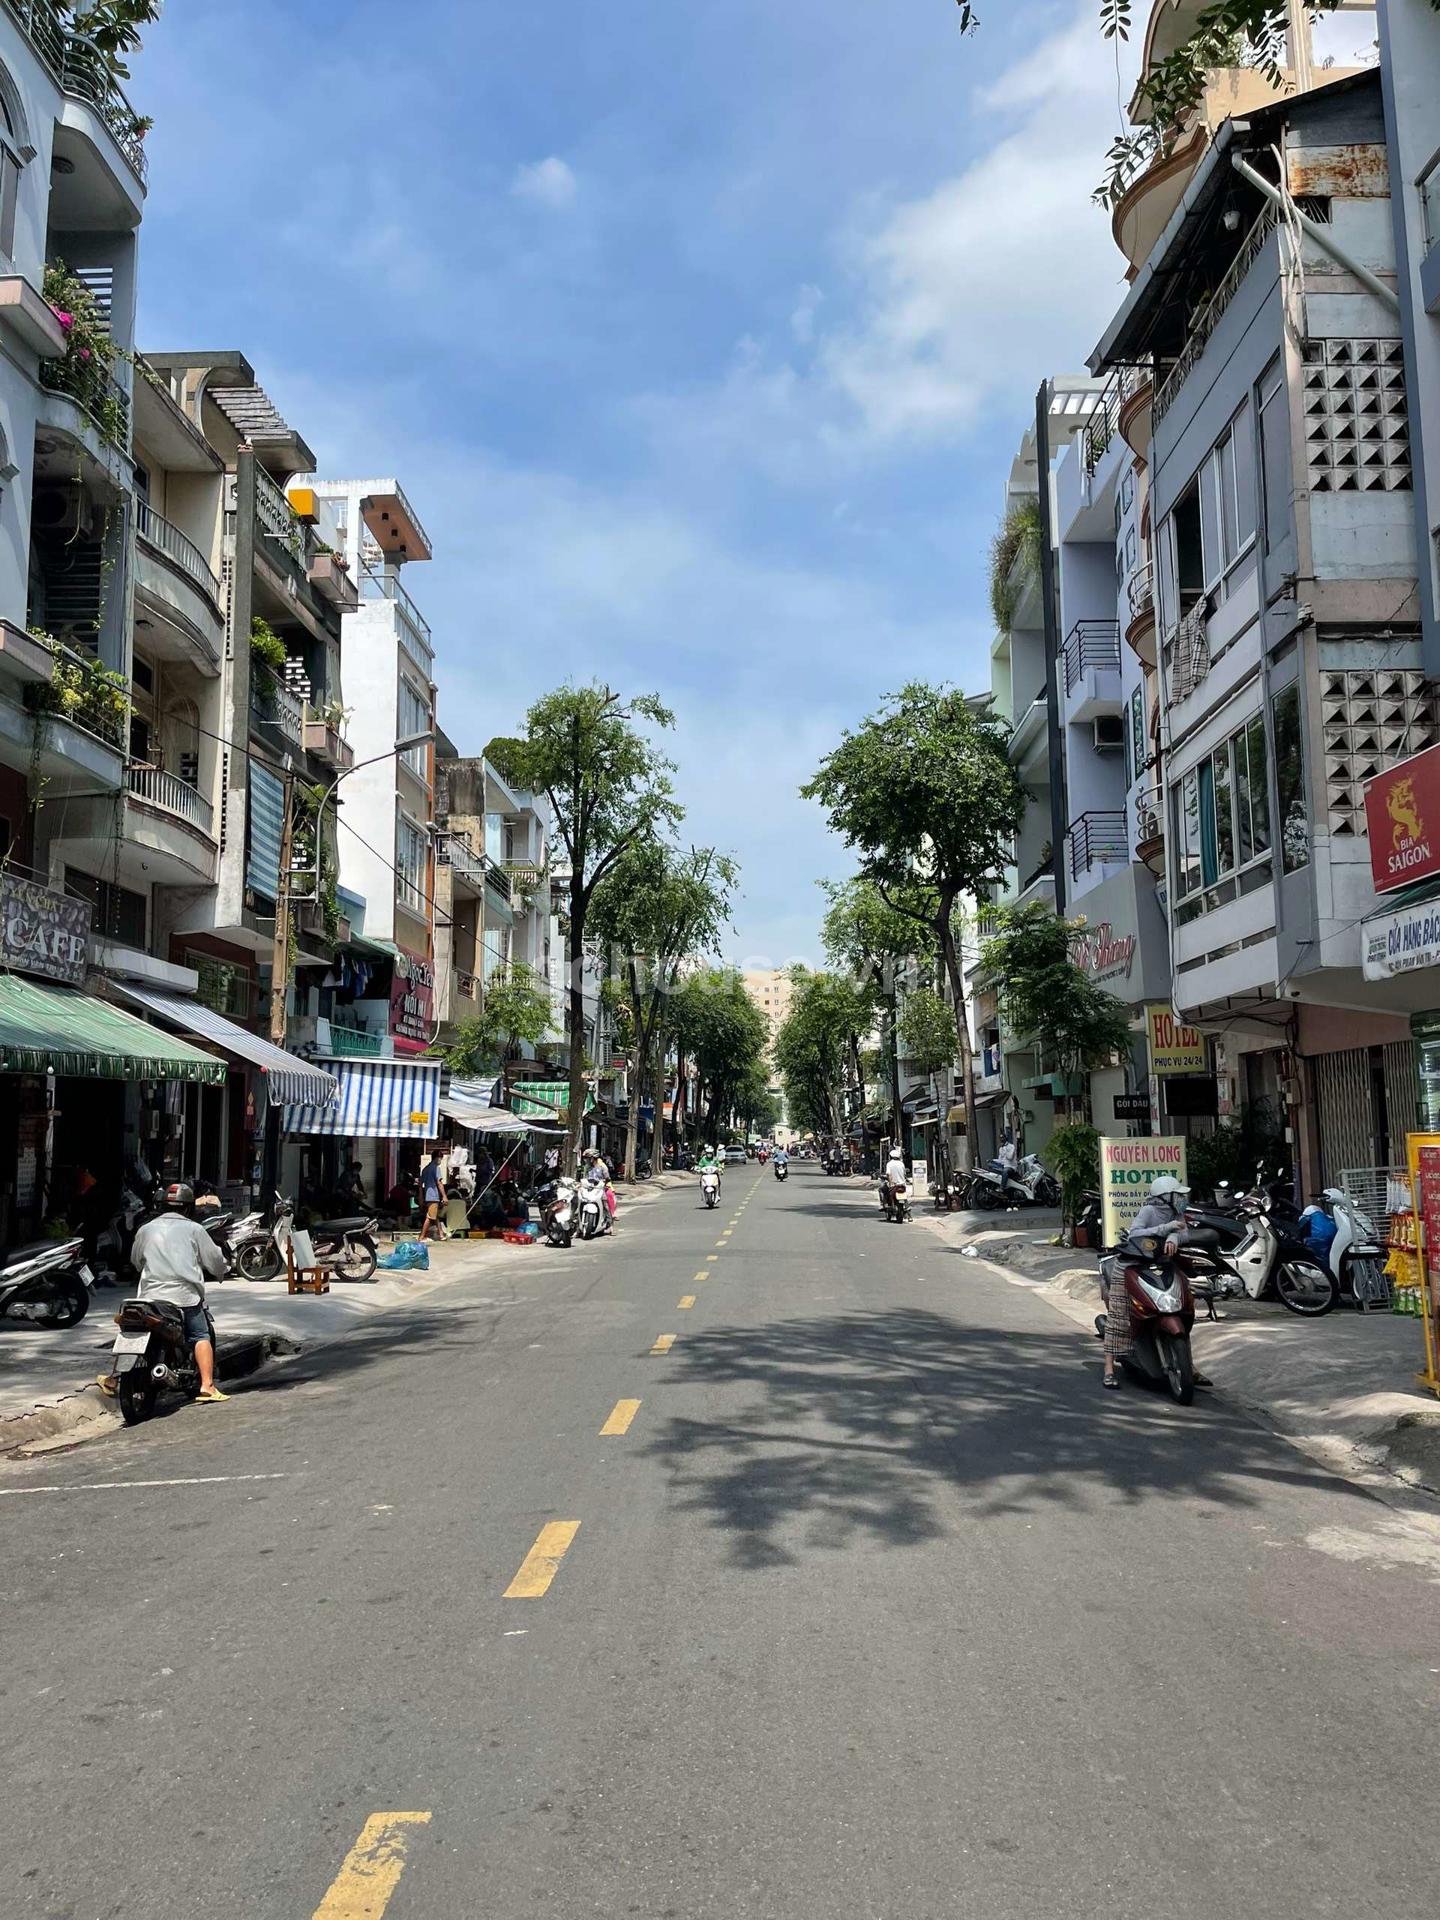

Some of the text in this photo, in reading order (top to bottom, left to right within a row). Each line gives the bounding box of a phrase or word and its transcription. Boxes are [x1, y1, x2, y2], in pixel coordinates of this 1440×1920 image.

[1401, 837, 1414, 850] BIA
[1388, 843, 1431, 873] SAIGON
[8, 918, 84, 964] CAFE
[1153, 1146, 1181, 1163] LONG
